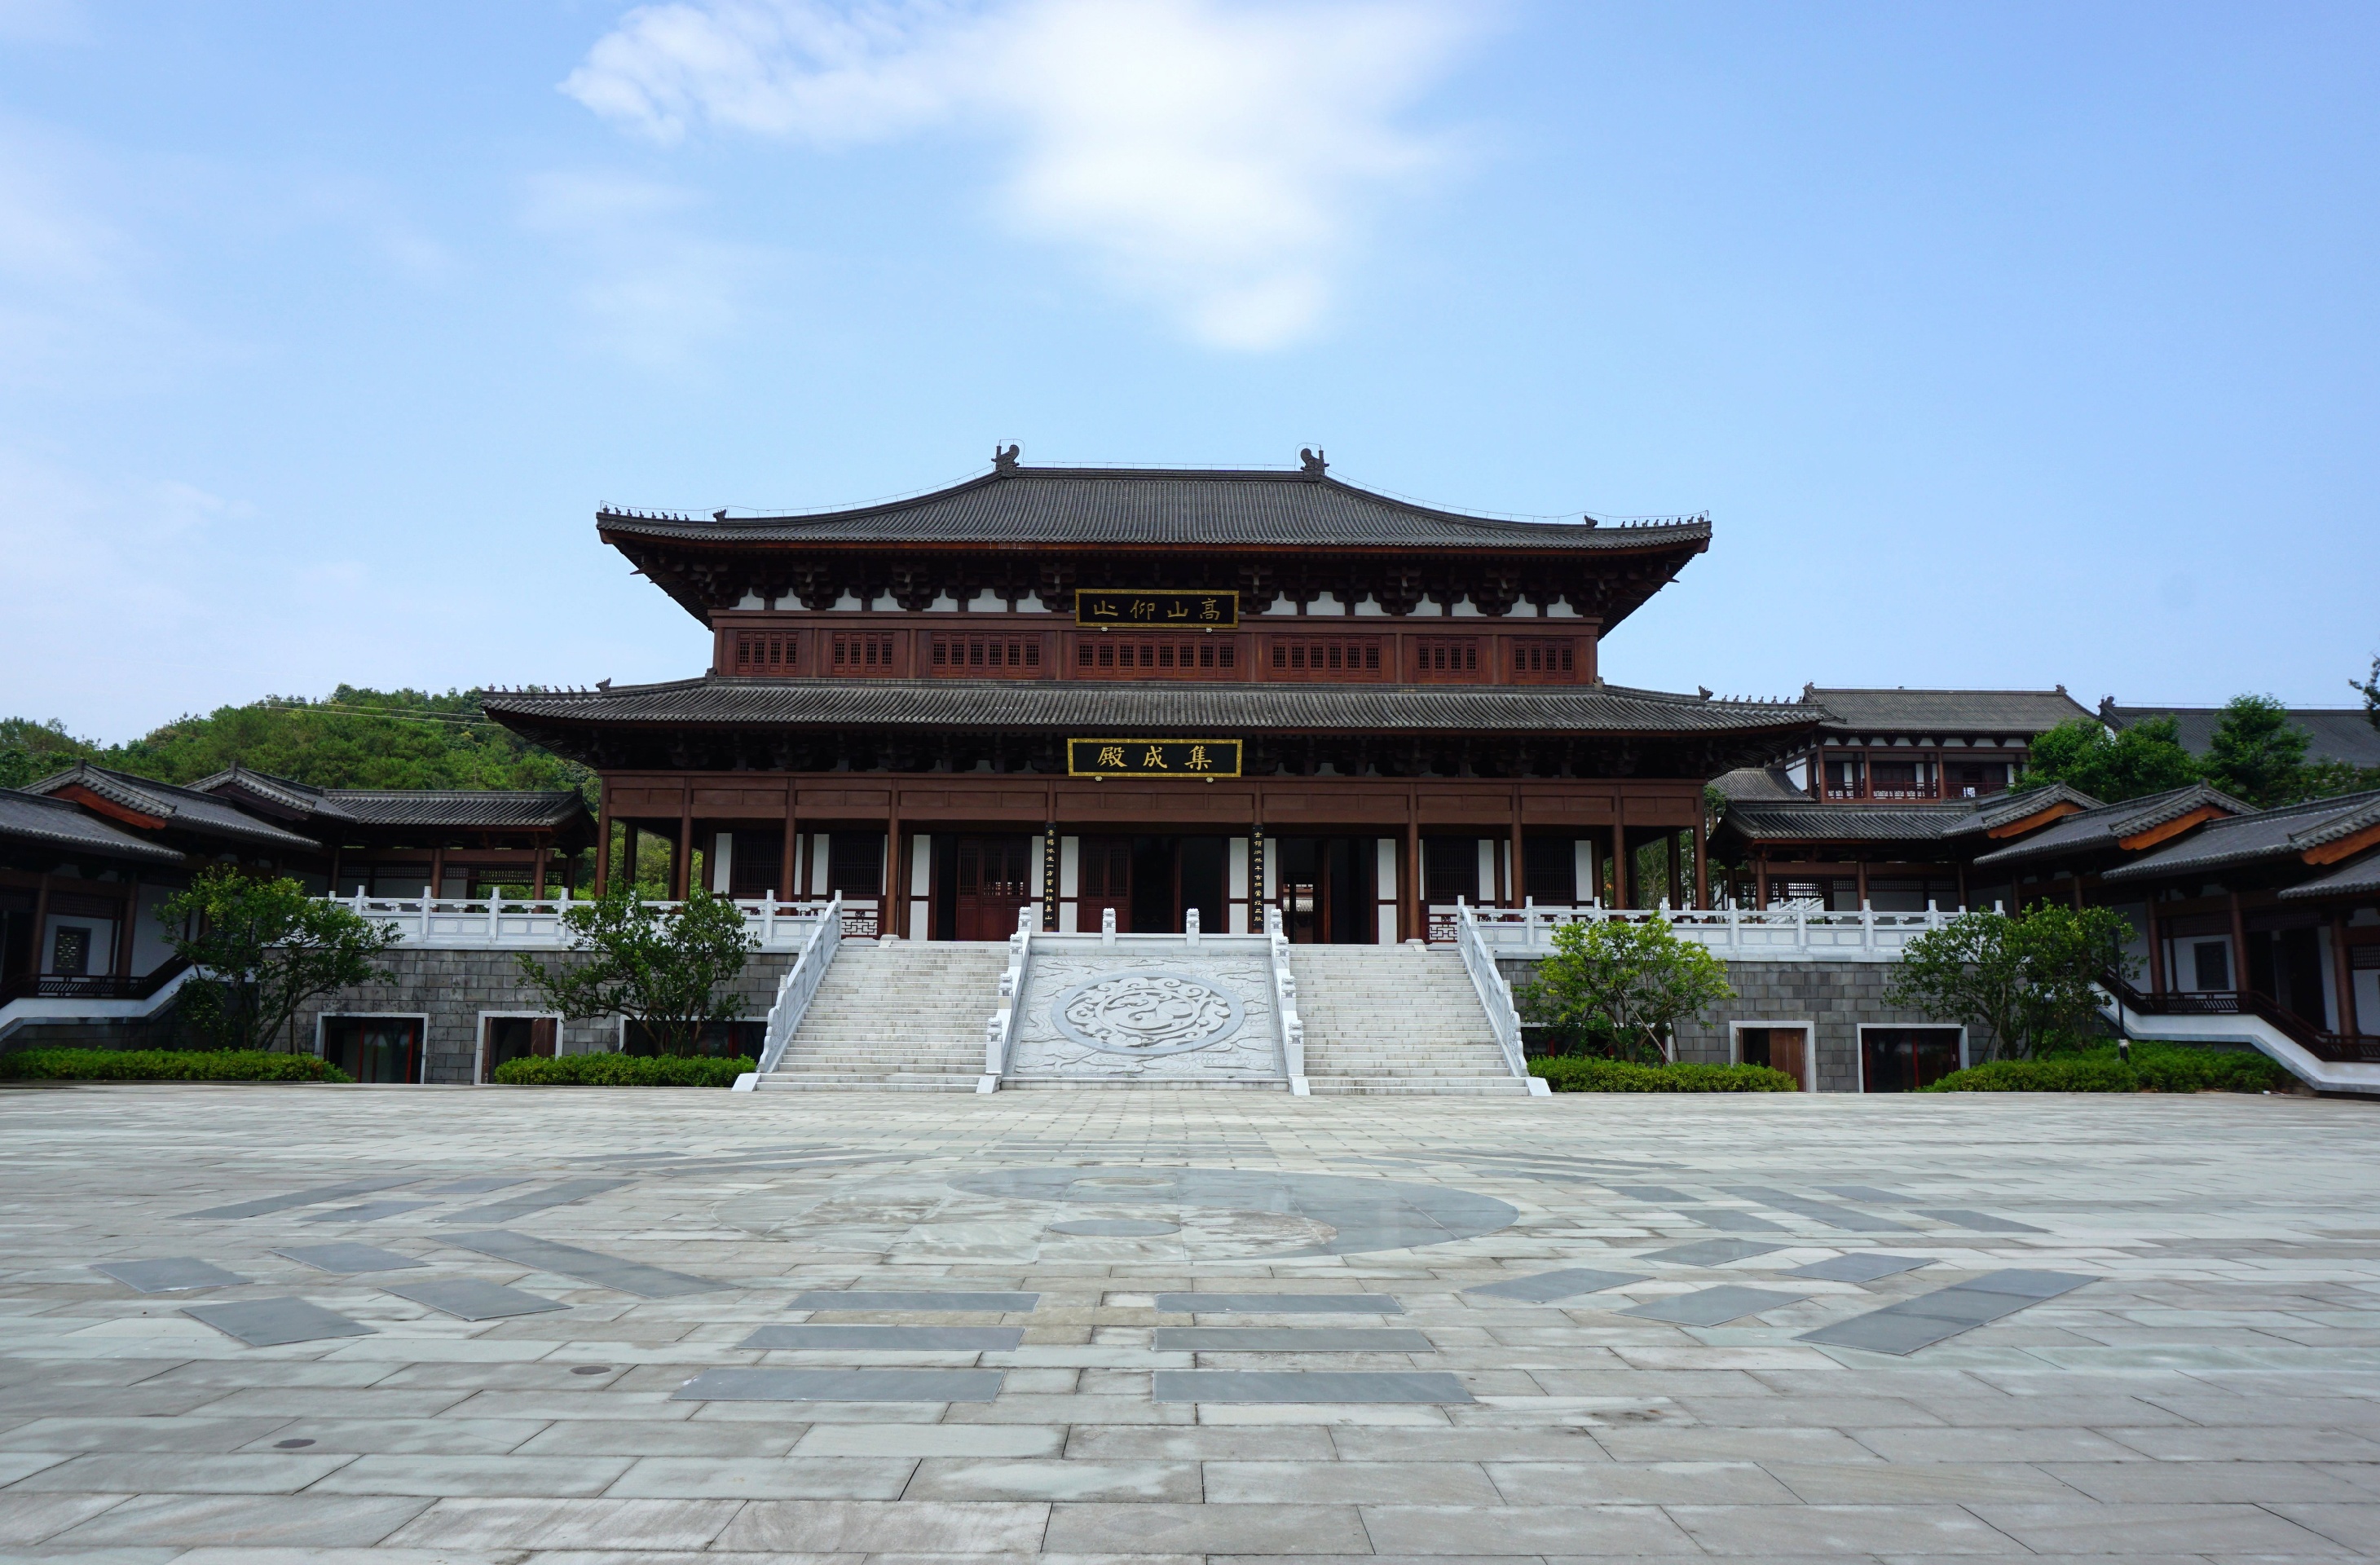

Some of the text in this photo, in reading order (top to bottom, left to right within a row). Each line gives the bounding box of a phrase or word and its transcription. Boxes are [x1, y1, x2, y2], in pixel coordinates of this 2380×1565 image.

[1093, 597, 1221, 621] 高山仰止
[1096, 744, 1213, 771] 集成殿
